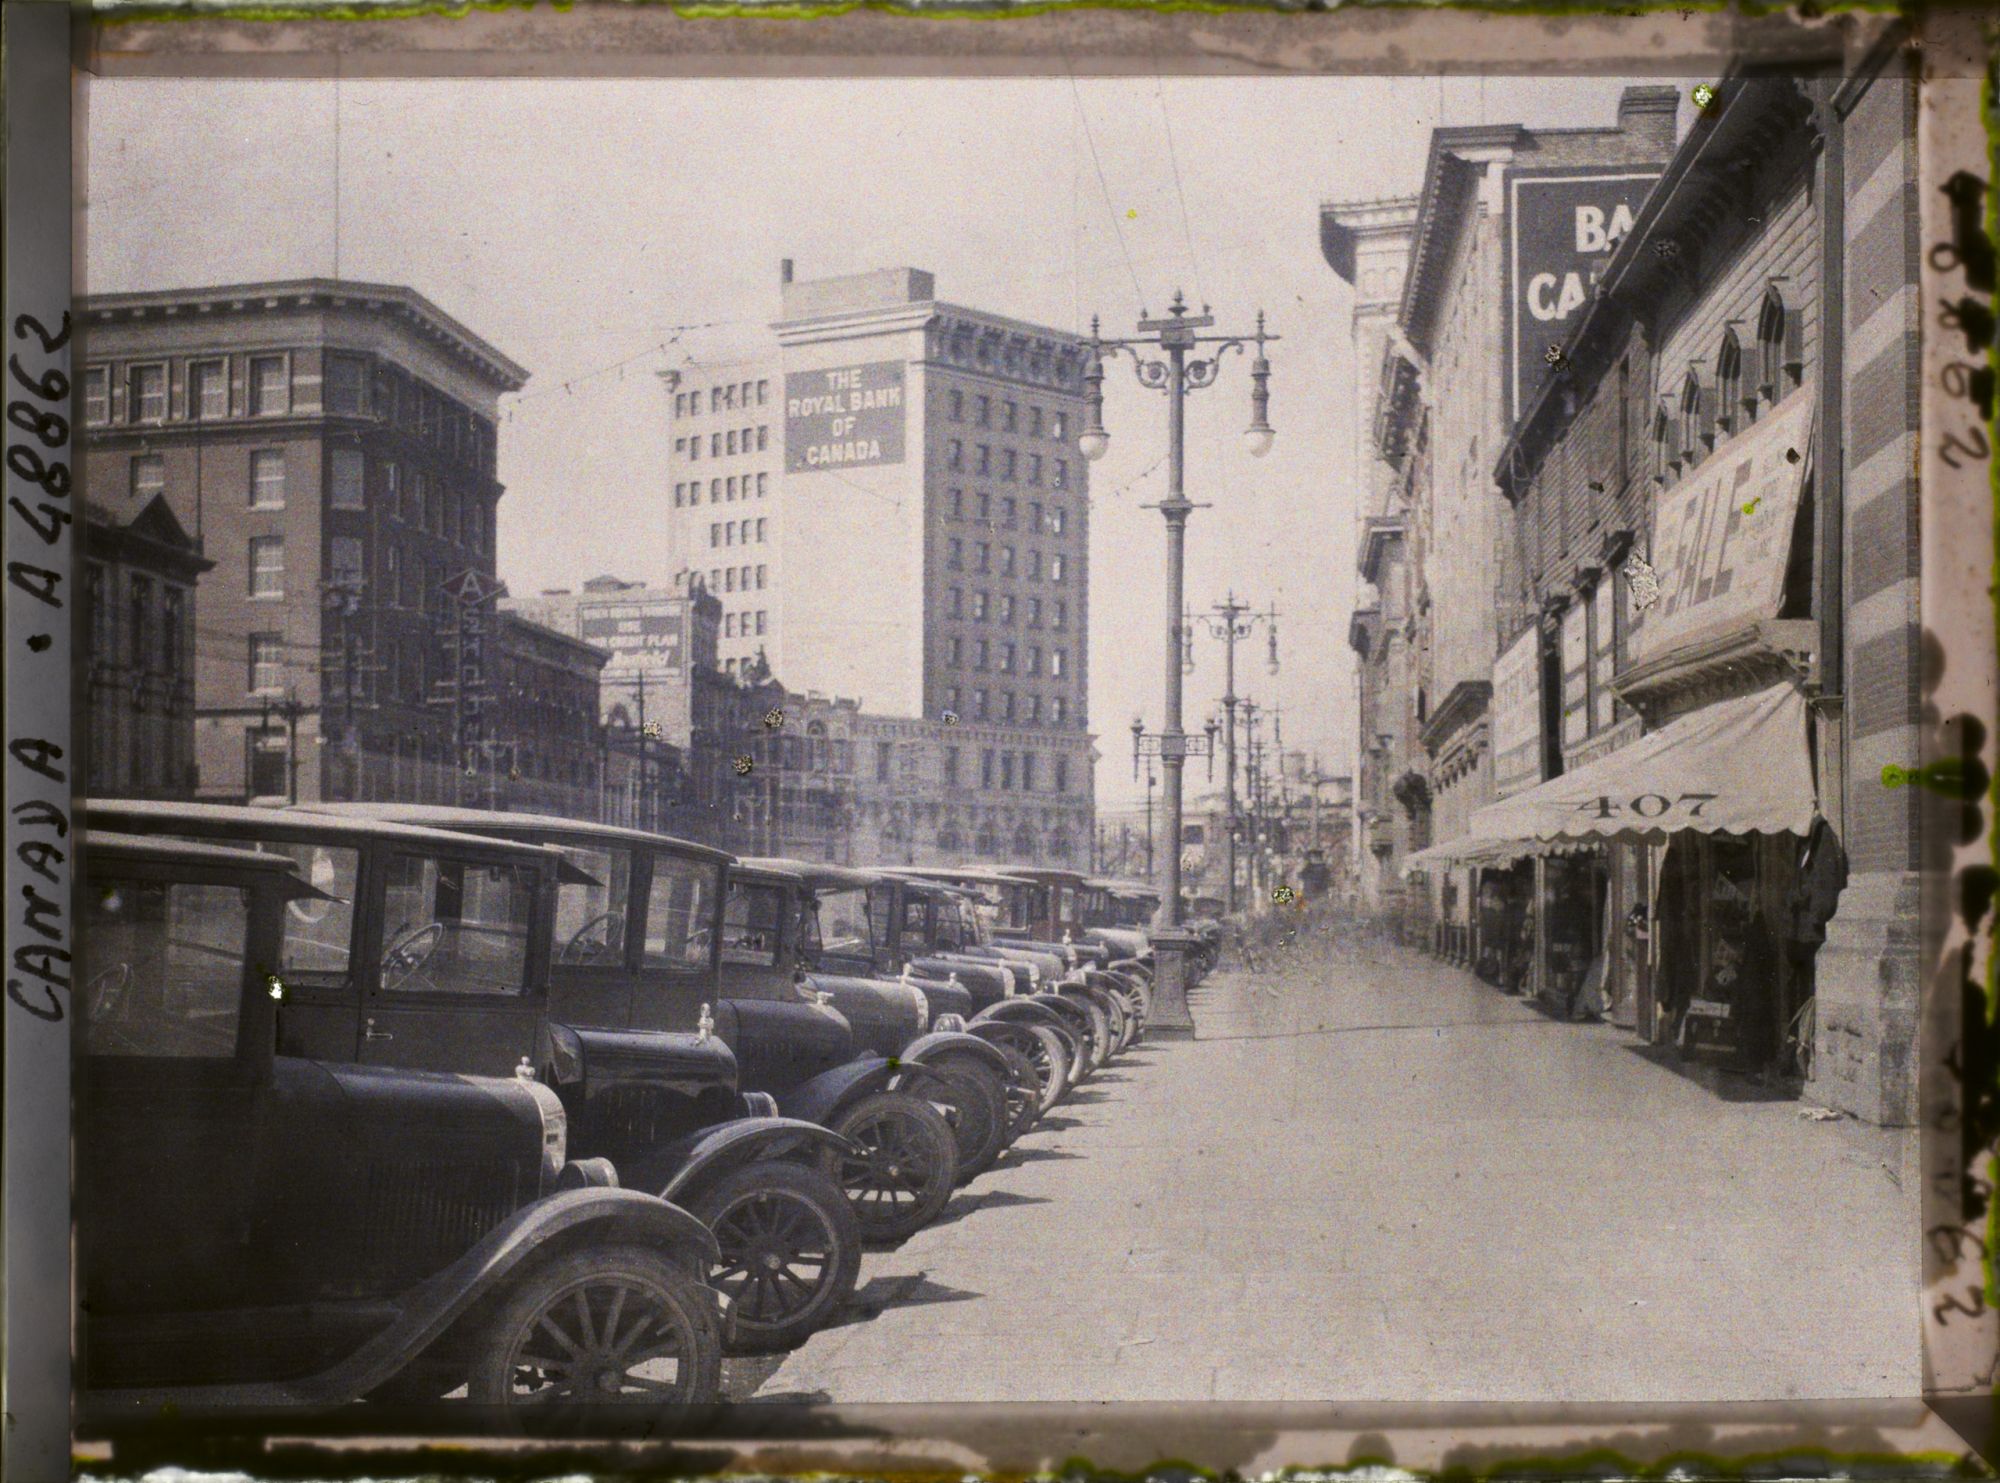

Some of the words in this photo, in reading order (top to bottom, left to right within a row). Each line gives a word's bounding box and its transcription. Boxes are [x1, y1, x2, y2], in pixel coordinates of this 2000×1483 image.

[1527, 272, 1596, 321] CA
[826, 369, 862, 390] THE
[788, 394, 846, 418] ROYAL
[850, 387, 901, 411] BANK
[833, 416, 857, 437] OF
[806, 440, 881, 465] CANADA
[1664, 457, 1752, 618] SALE
[1577, 793, 1718, 819] 407
